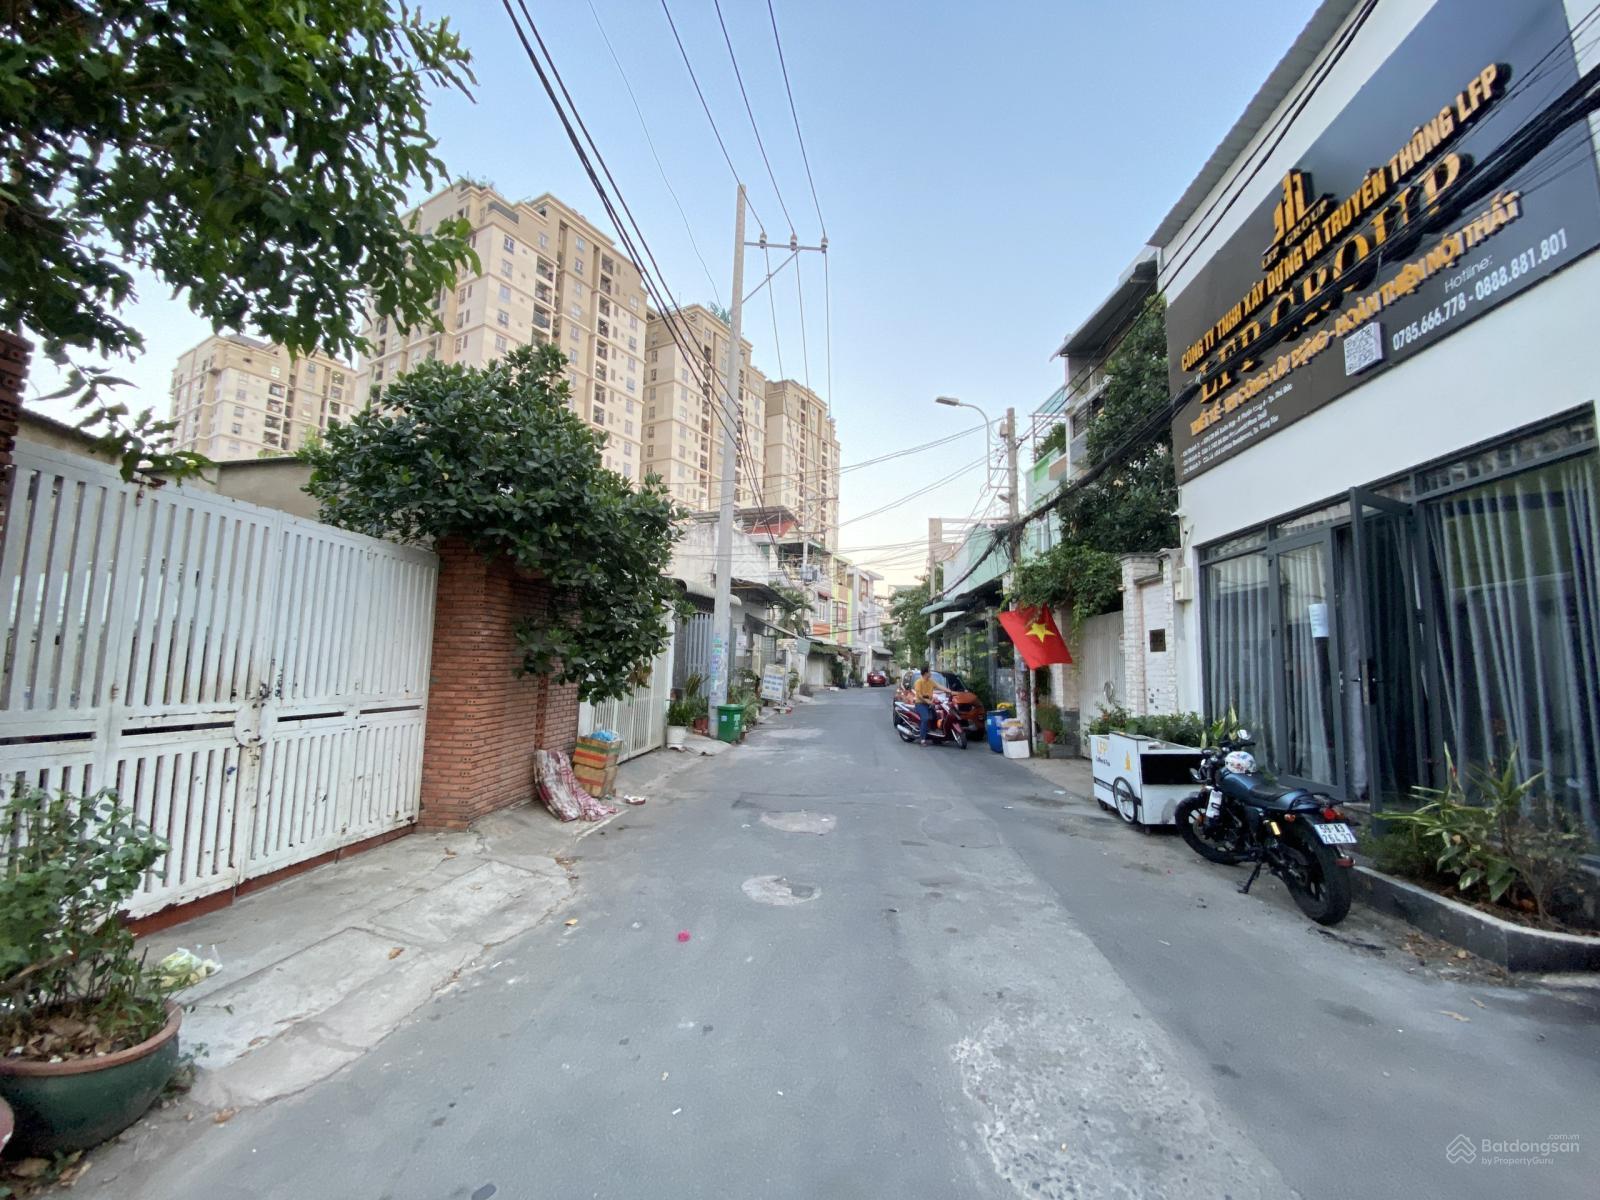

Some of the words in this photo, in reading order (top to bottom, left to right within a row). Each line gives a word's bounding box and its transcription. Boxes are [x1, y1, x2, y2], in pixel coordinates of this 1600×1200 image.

[1181, 339, 1204, 372] CÔNG
[1204, 326, 1215, 351] TY
[1217, 301, 1242, 340] TNHH
[1243, 281, 1264, 316] XÂY
[1266, 245, 1304, 291] DỰNG
[1304, 225, 1323, 261] VÀ
[1322, 168, 1387, 244] TRUYỀN
[1389, 105, 1455, 184] THÔNG
[1456, 63, 1498, 123] LFP
[1284, 199, 1328, 247] GROUP
[1424, 231, 1464, 274] NỘI
[1462, 190, 1520, 248] THẤT
[1392, 292, 1467, 351] 0785.666.778
[1475, 227, 1567, 301] 0888.881.801
[1444, 254, 1494, 294] Hotline:
